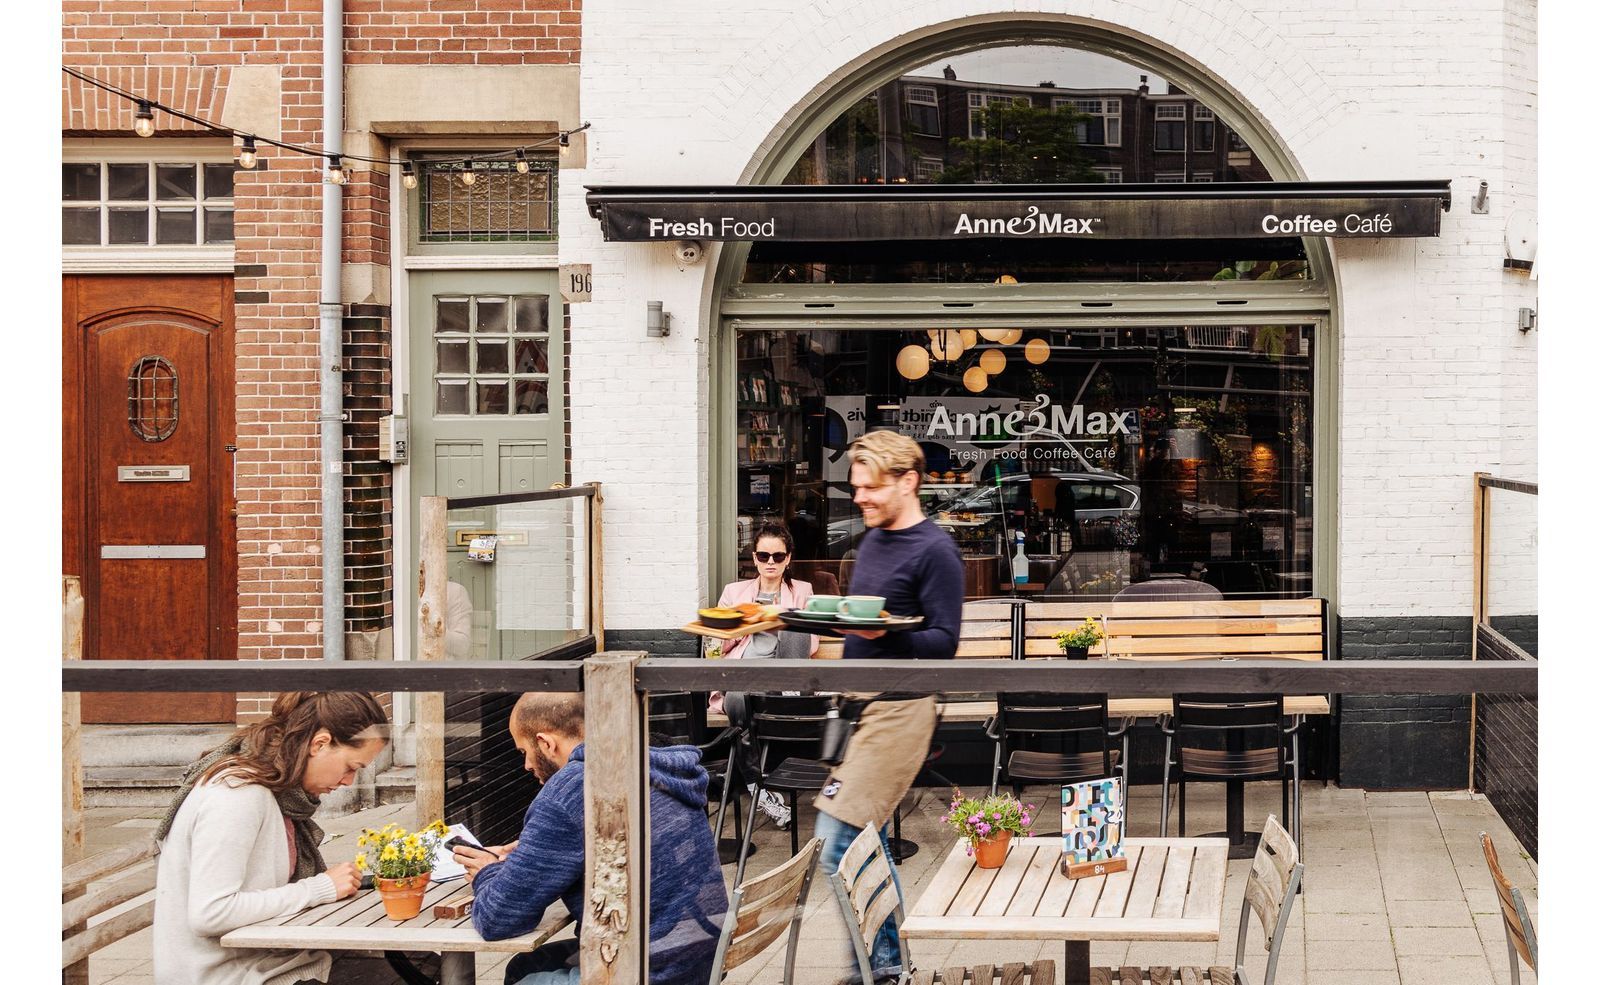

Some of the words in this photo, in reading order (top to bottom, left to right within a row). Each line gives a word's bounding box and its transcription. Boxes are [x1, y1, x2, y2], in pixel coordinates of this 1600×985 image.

[648, 217, 713, 237] Fresh
[721, 217, 775, 237] Food
[1261, 214, 1337, 234] Coffee
[1343, 213, 1393, 233] Café
[570, 273, 592, 293] 196
[949, 448, 987, 460] Fresh
[993, 448, 1028, 460] Food
[1033, 447, 1079, 459] Coffee
[1084, 446, 1117, 458] Café
